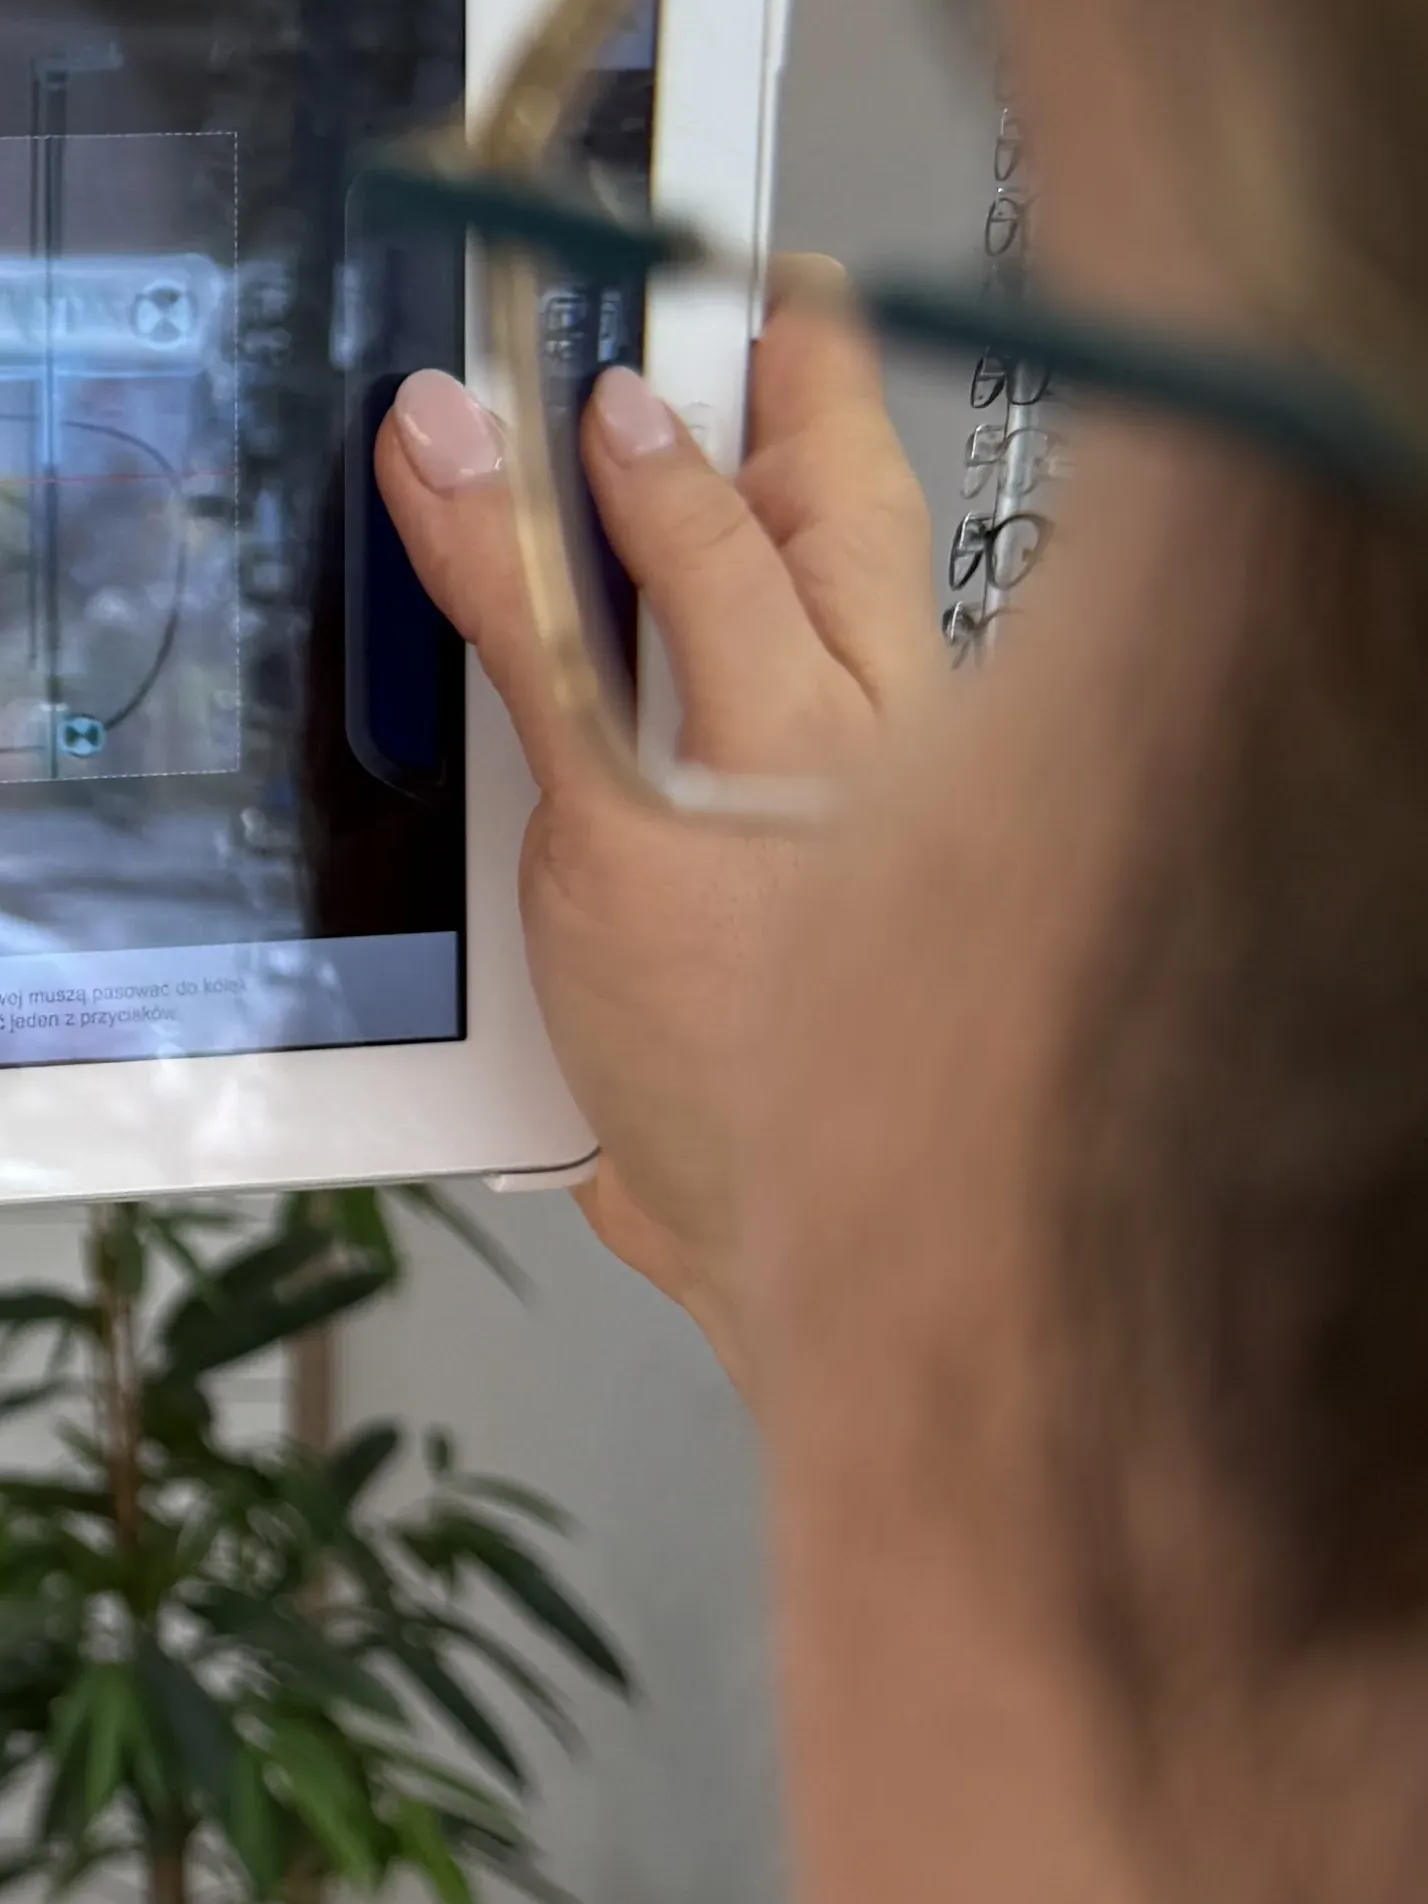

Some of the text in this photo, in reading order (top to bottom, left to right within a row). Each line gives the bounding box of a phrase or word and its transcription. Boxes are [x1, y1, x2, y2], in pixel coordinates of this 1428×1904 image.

[29, 987, 86, 1007] muszą
[176, 980, 197, 996] do
[9, 1011, 59, 1033] jeden
[65, 1013, 75, 1026] z
